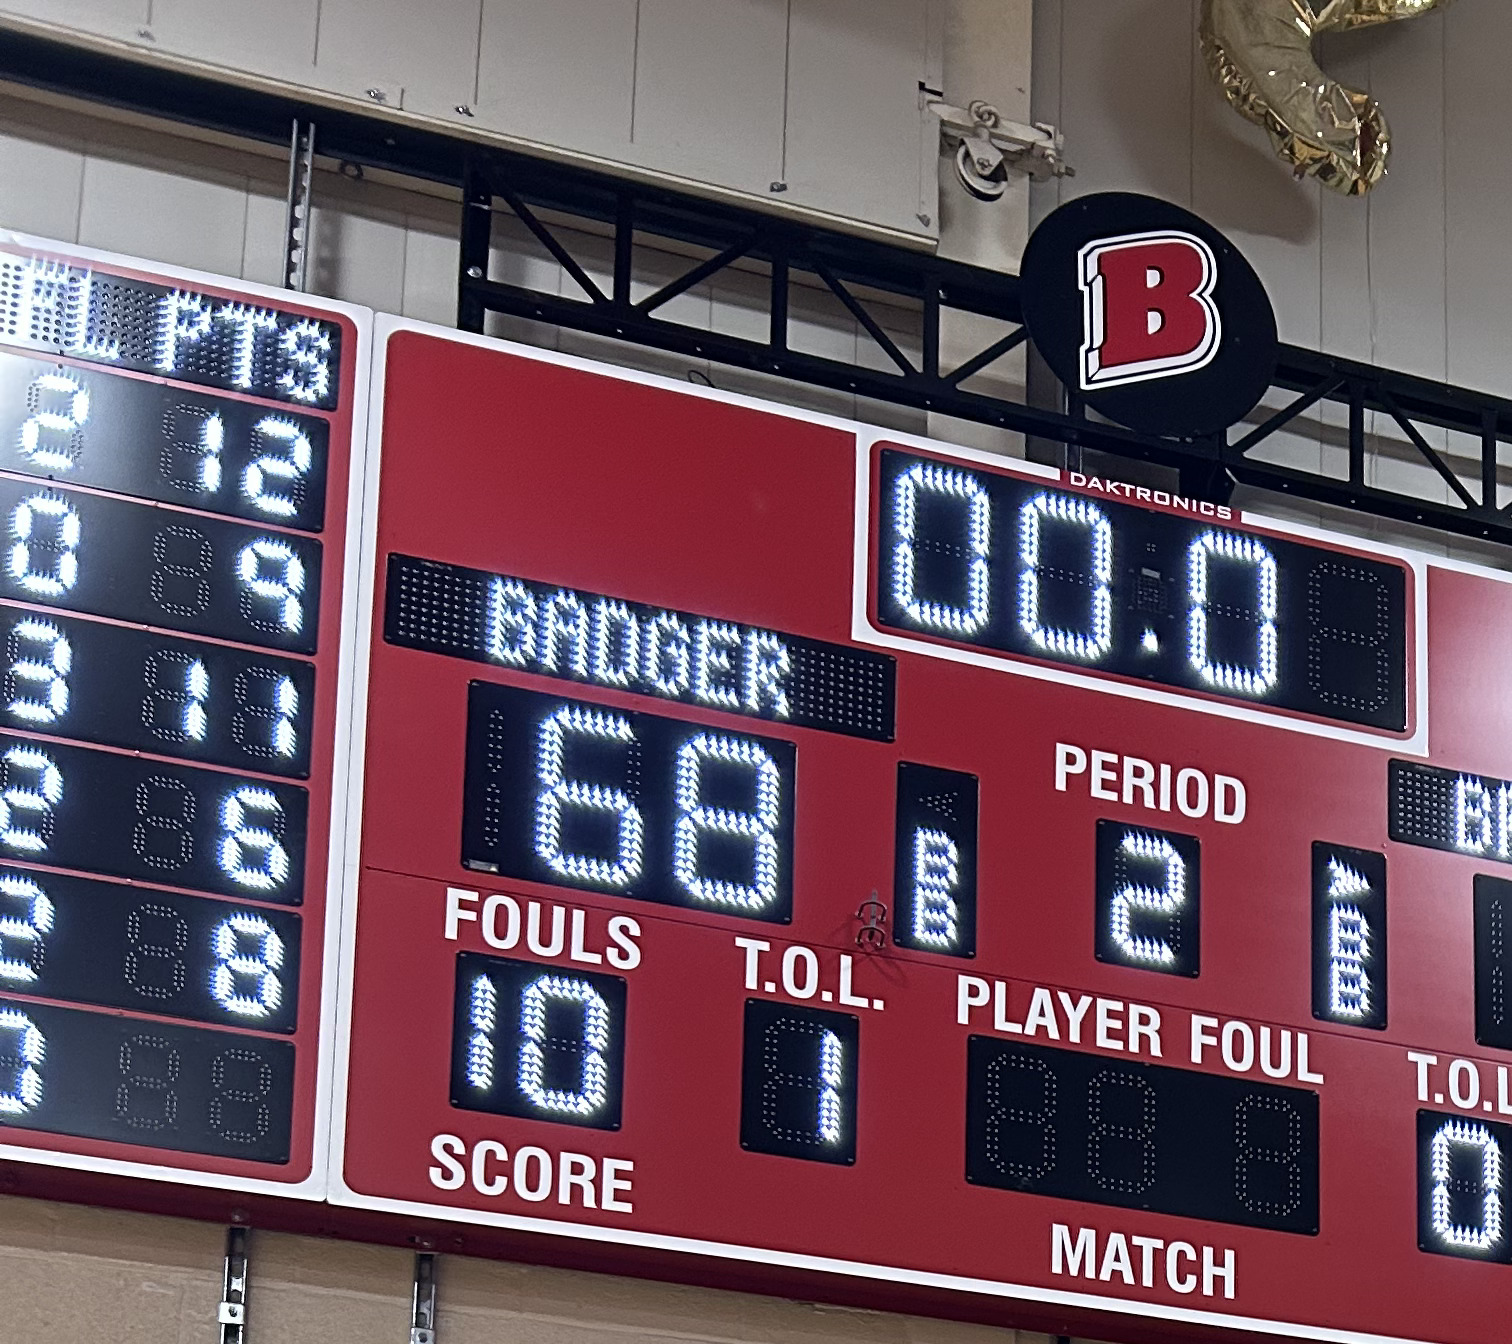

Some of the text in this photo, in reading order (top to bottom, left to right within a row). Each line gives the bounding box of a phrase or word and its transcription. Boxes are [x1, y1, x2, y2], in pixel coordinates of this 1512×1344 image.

[155, 288, 330, 403] PTS
[1078, 230, 1221, 390] B
[20, 366, 312, 518] 2 12
[1069, 471, 1232, 520] DAKTRONICS
[10, 490, 304, 633] 0 9
[892, 461, 1280, 697] 00.0
[6, 617, 300, 760] 3 11
[487, 576, 791, 718] BADGER
[219, 788, 288, 889] 6
[534, 702, 782, 911] 68
[1056, 743, 1245, 824] PERIOD
[444, 886, 642, 971] FOULS
[1112, 832, 1186, 964] 2
[212, 914, 284, 1017] 8
[736, 937, 883, 1010] T.O.L.
[468, 976, 608, 1115] 10
[820, 1031, 842, 1143] 1
[958, 975, 1323, 1084] PLAYER FOUL
[428, 1133, 635, 1214] SCORE
[1431, 1119, 1504, 1251] 0
[1050, 1223, 1236, 1300] MATCH
